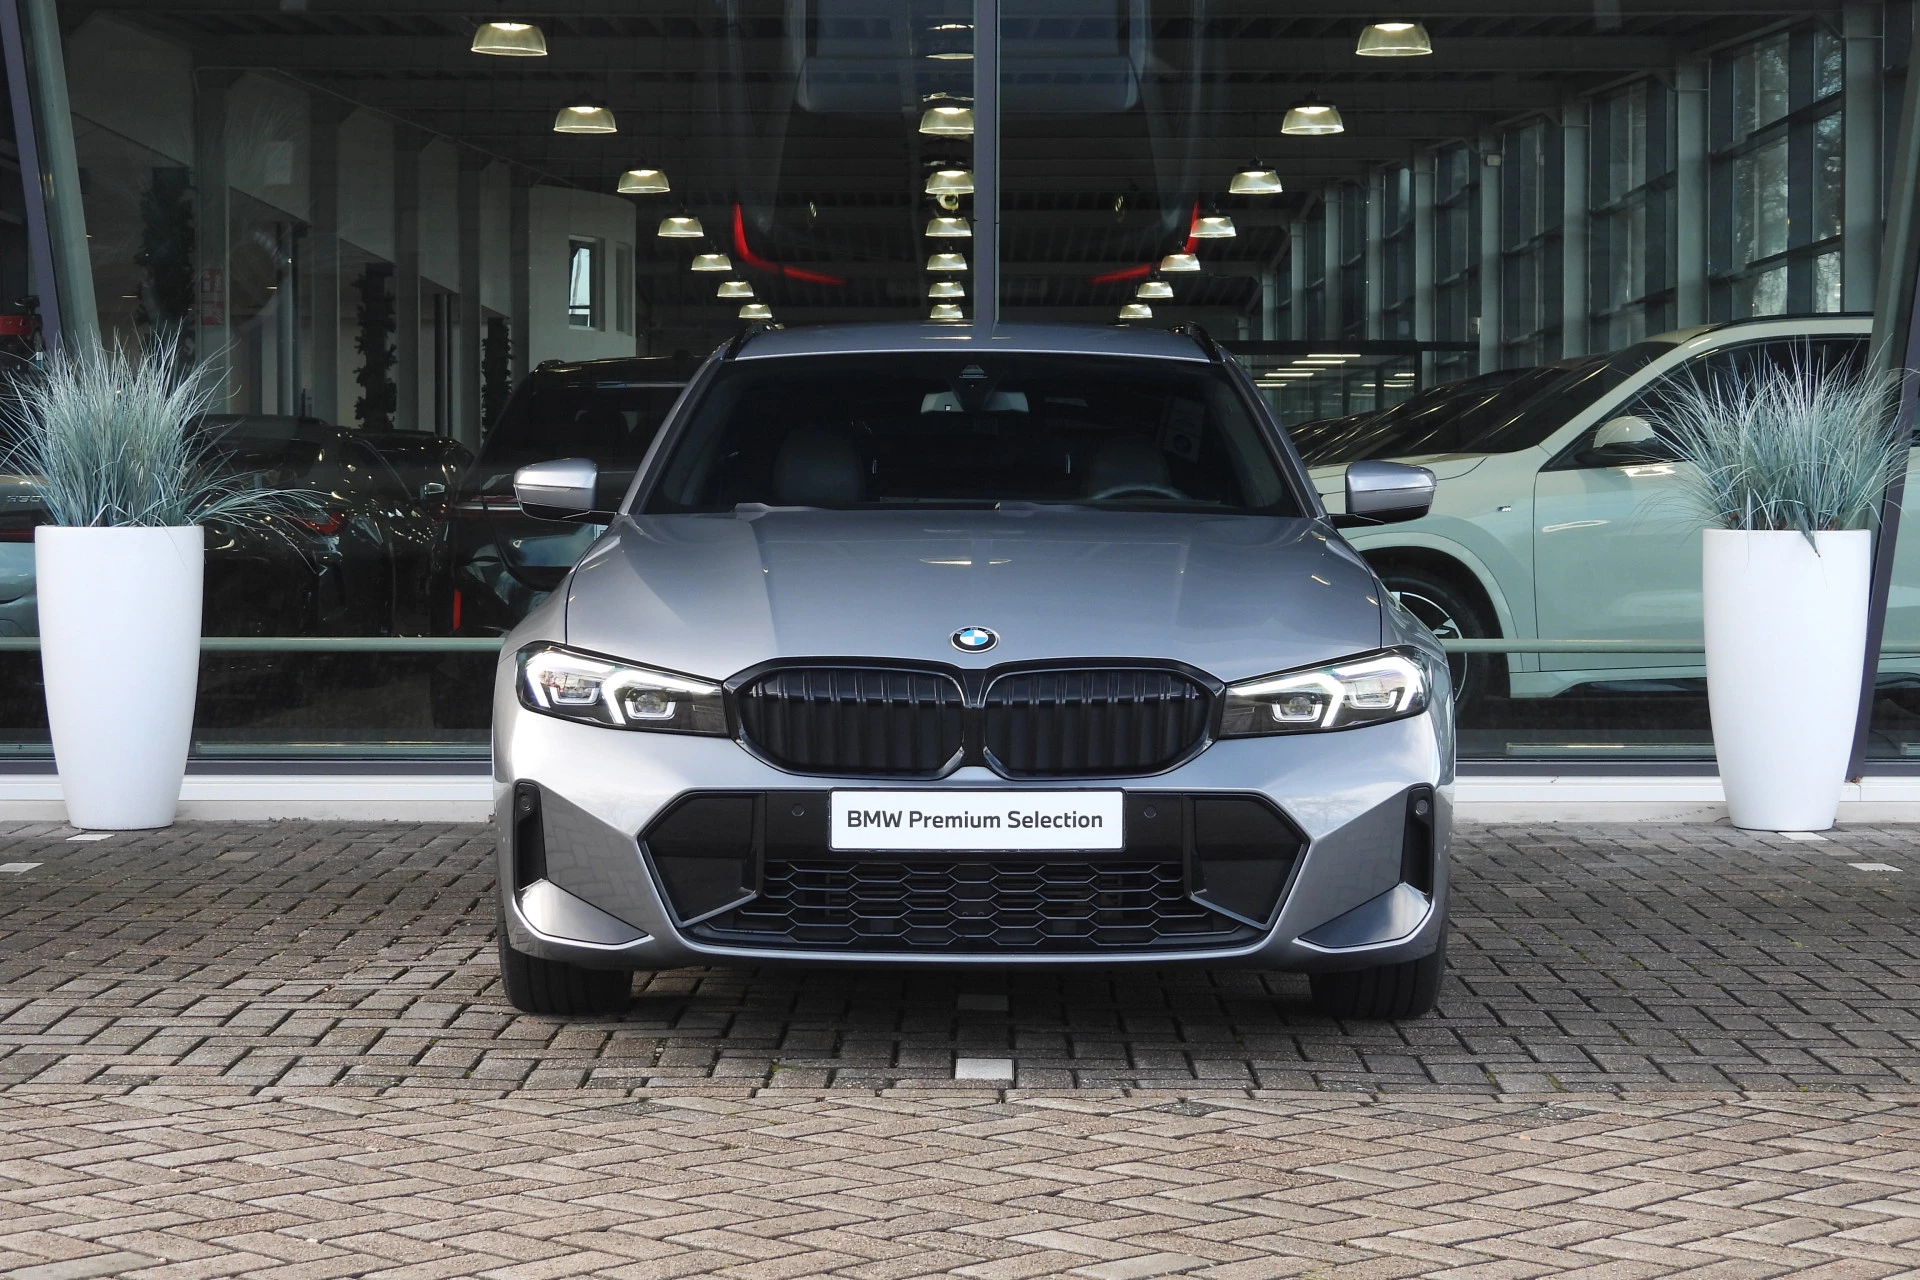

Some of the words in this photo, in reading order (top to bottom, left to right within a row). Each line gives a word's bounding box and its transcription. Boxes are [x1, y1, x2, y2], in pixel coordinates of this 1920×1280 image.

[847, 810, 903, 828] BMW
[909, 810, 1001, 828] Premium
[1007, 810, 1103, 828] Selection
